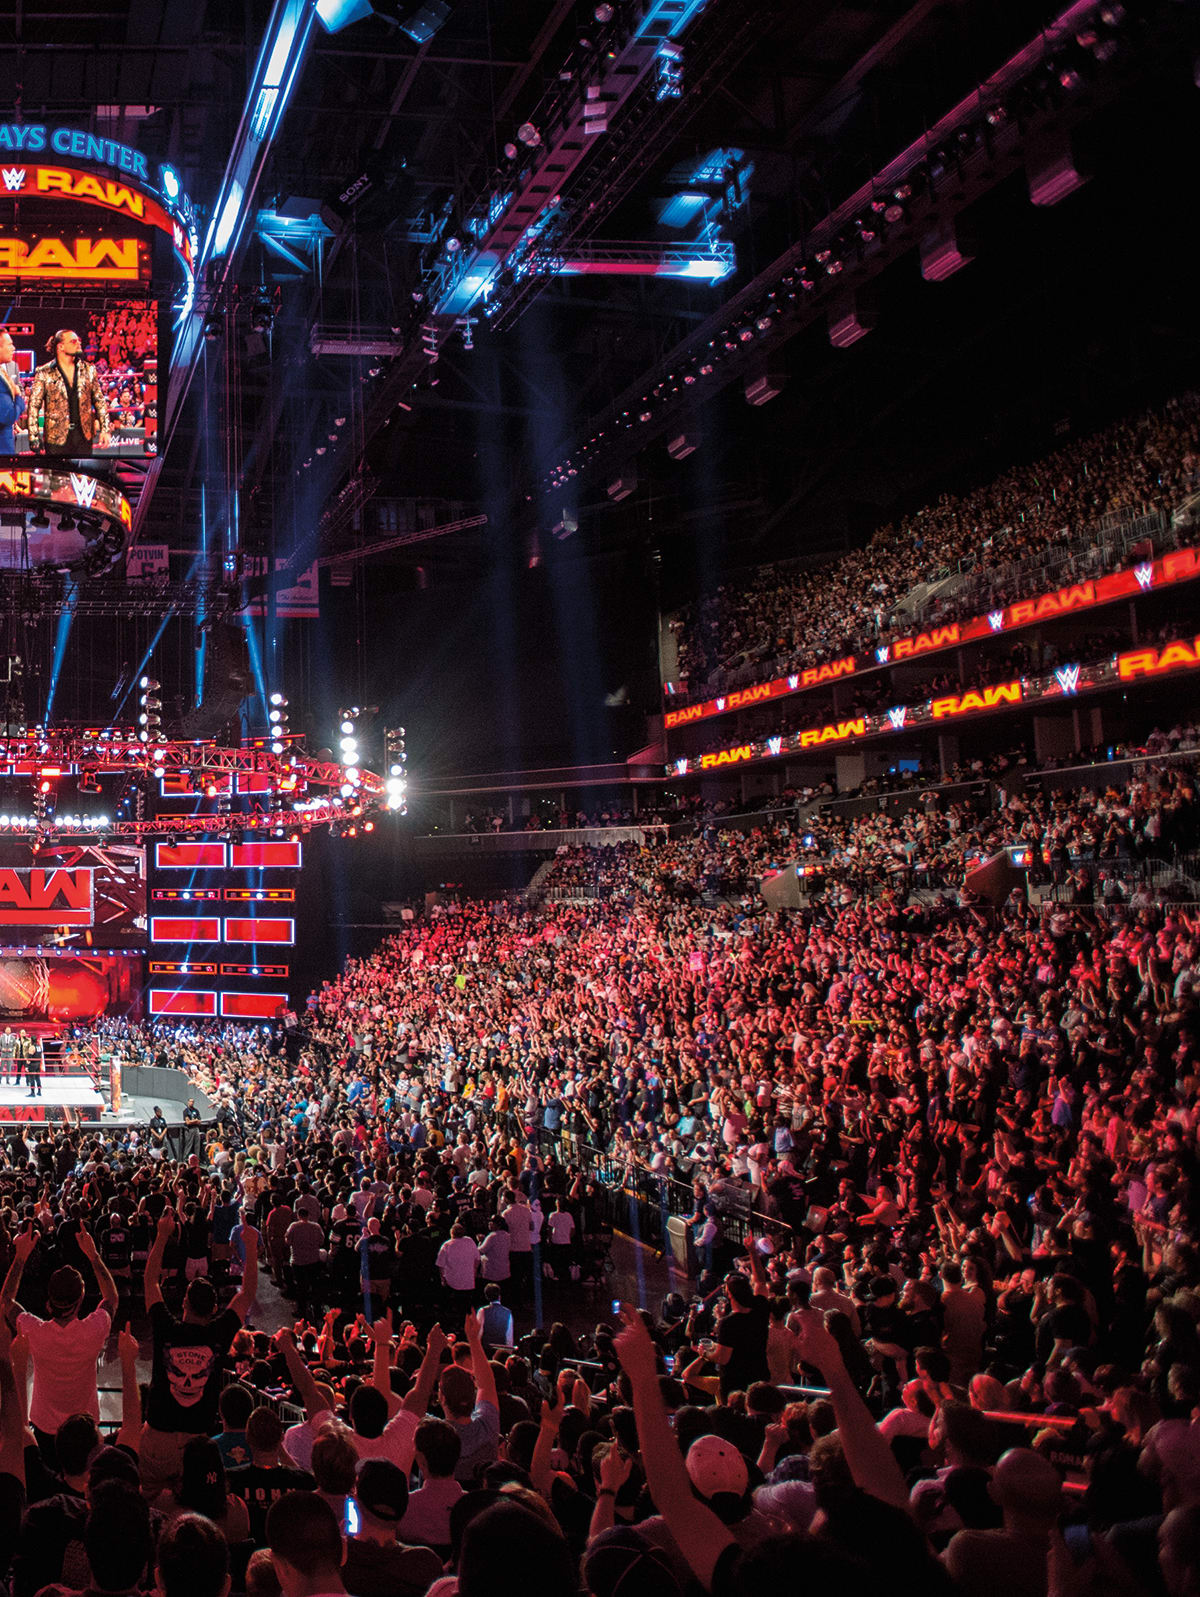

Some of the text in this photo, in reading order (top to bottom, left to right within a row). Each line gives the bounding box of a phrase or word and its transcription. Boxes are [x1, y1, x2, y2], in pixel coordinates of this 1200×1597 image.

[52, 127, 148, 180] CENTER
[37, 169, 145, 217] RAW
[338, 172, 368, 203] SONY
[121, 437, 140, 445] LIVE
[131, 550, 163, 560] POTVIN
[666, 706, 702, 727] RAW
[727, 683, 770, 707] RAW
[803, 656, 855, 685] RAW
[894, 624, 959, 659] RAW
[1010, 581, 1095, 623] RAW
[702, 745, 751, 769] RAW
[801, 719, 866, 746] RAW
[932, 682, 1021, 718] RAW
[1118, 634, 1200, 680] RA
[177, 1352, 206, 1361] STONE
